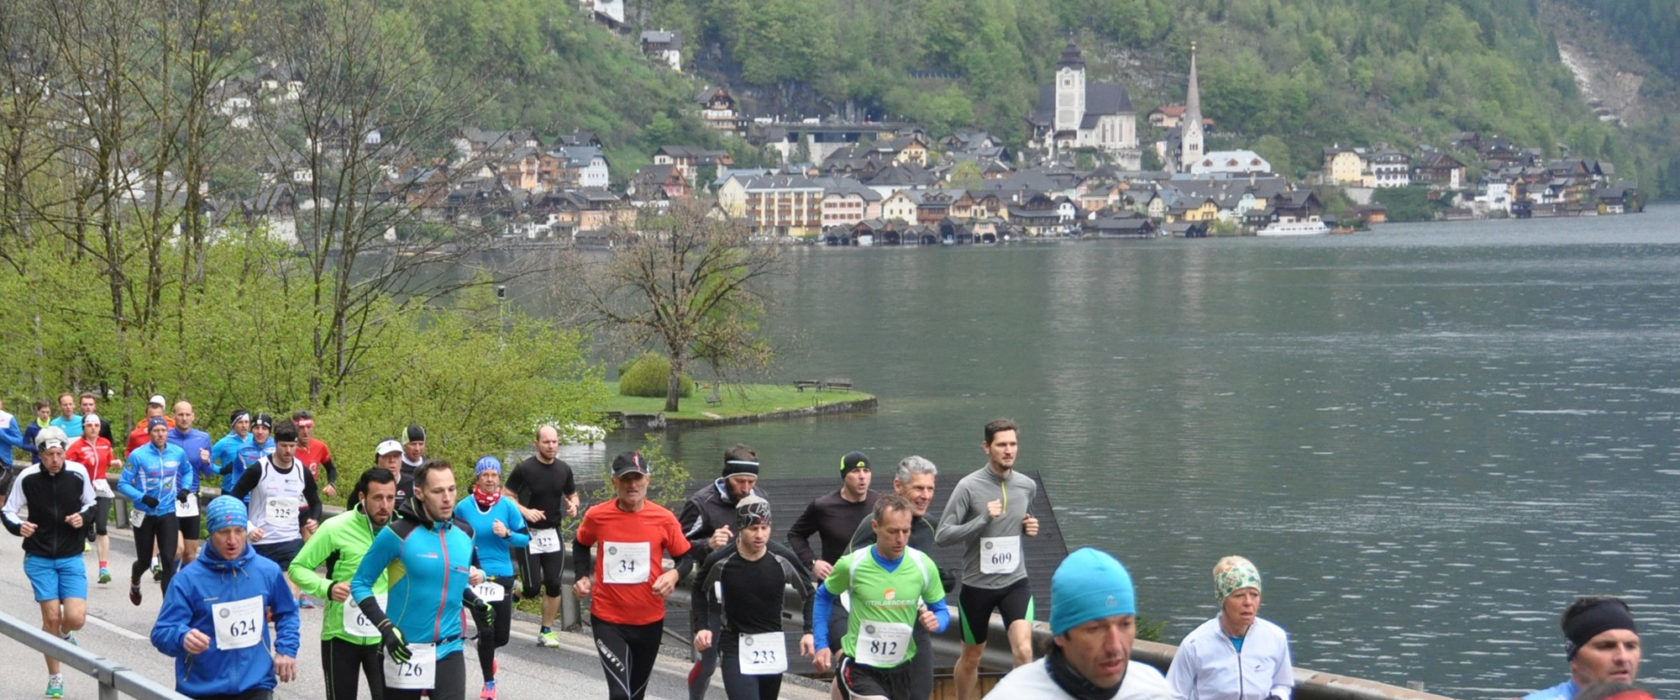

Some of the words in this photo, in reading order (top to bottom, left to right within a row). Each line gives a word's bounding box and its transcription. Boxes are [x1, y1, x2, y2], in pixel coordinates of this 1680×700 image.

[991, 552, 1012, 565] 609
[619, 559, 635, 573] 34
[230, 618, 256, 638] 624
[870, 639, 897, 656] 812
[752, 650, 776, 664] 233
